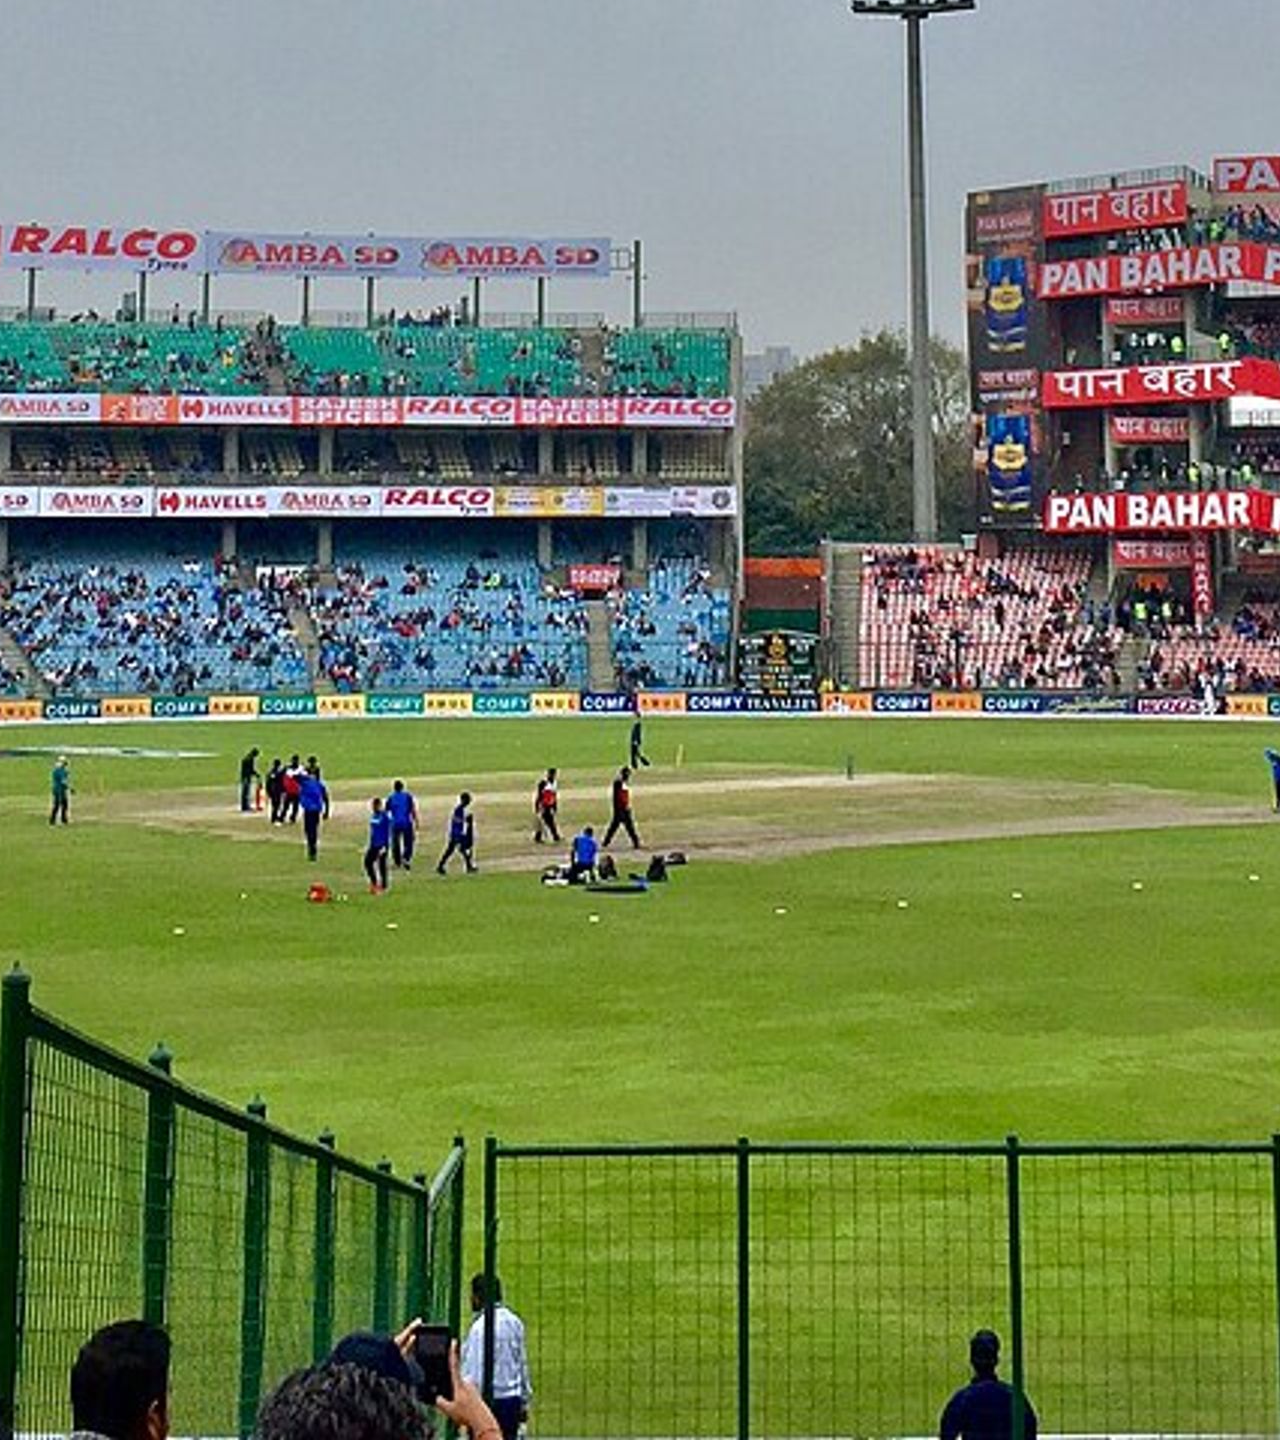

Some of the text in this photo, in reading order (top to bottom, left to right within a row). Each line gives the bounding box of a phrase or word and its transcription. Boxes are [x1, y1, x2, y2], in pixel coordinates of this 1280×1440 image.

[1050, 184, 1180, 226] पान बहार
[10, 225, 198, 259] RALCO
[236, 241, 400, 264] AMBA SD
[438, 243, 601, 266] AMBA SD
[1041, 246, 1243, 296] PAN BAHAR
[1054, 368, 1130, 400] पान
[1138, 360, 1243, 398] बहार
[207, 400, 289, 417] HAVELLS
[406, 398, 513, 415] RALCO
[627, 400, 733, 416] RALCO
[184, 495, 267, 509] HAVELLS
[384, 489, 492, 506] RALCO
[1050, 492, 1250, 530] PAN BAHAR
[46, 703, 99, 718] COMFY
[153, 700, 208, 716] COMFY
[261, 697, 315, 712] COMFY
[370, 696, 422, 710] COMFY
[476, 696, 529, 710] COMFY
[534, 697, 576, 710] AMUL
[689, 695, 743, 710] COMFY
[876, 696, 929, 710] COMFY
[984, 696, 1041, 711] COMFY
